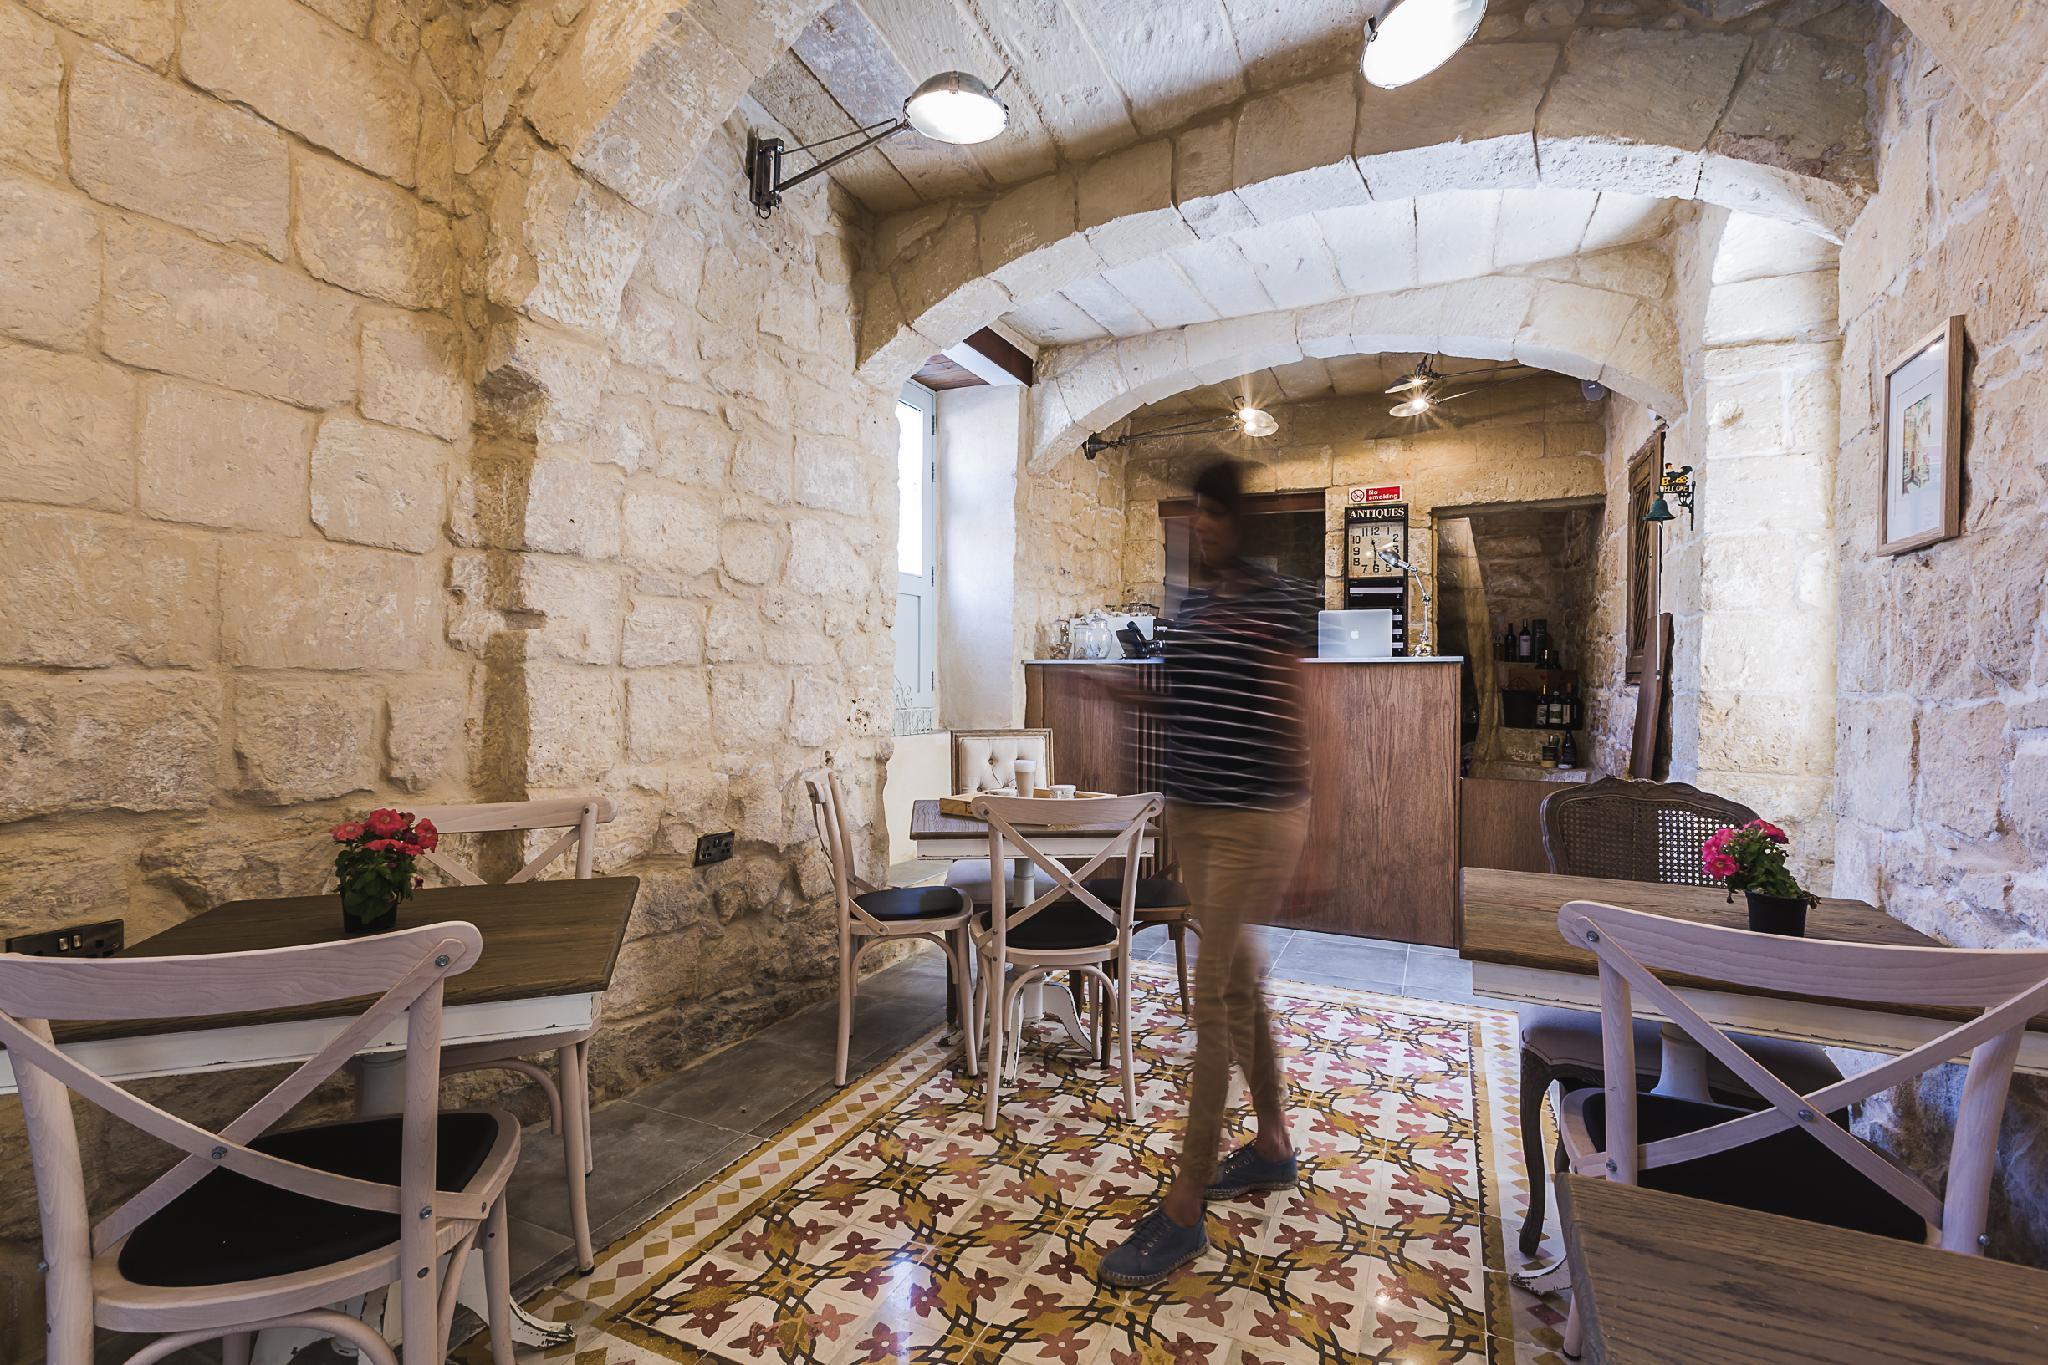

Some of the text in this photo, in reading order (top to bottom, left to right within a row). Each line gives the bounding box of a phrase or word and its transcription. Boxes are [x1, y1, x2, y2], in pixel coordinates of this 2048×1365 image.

[1350, 507, 1404, 518] ANTIQUES
[1361, 527, 1368, 537] 11
[1370, 526, 1380, 536] 12
[1352, 535, 1360, 544] 10
[1392, 534, 1399, 542] 2
[1353, 547, 1360, 555] 9
[1353, 557, 1360, 566] 8
[1361, 564, 1368, 573] 7
[1372, 564, 1380, 573] 6
[1385, 563, 1392, 573] 5
